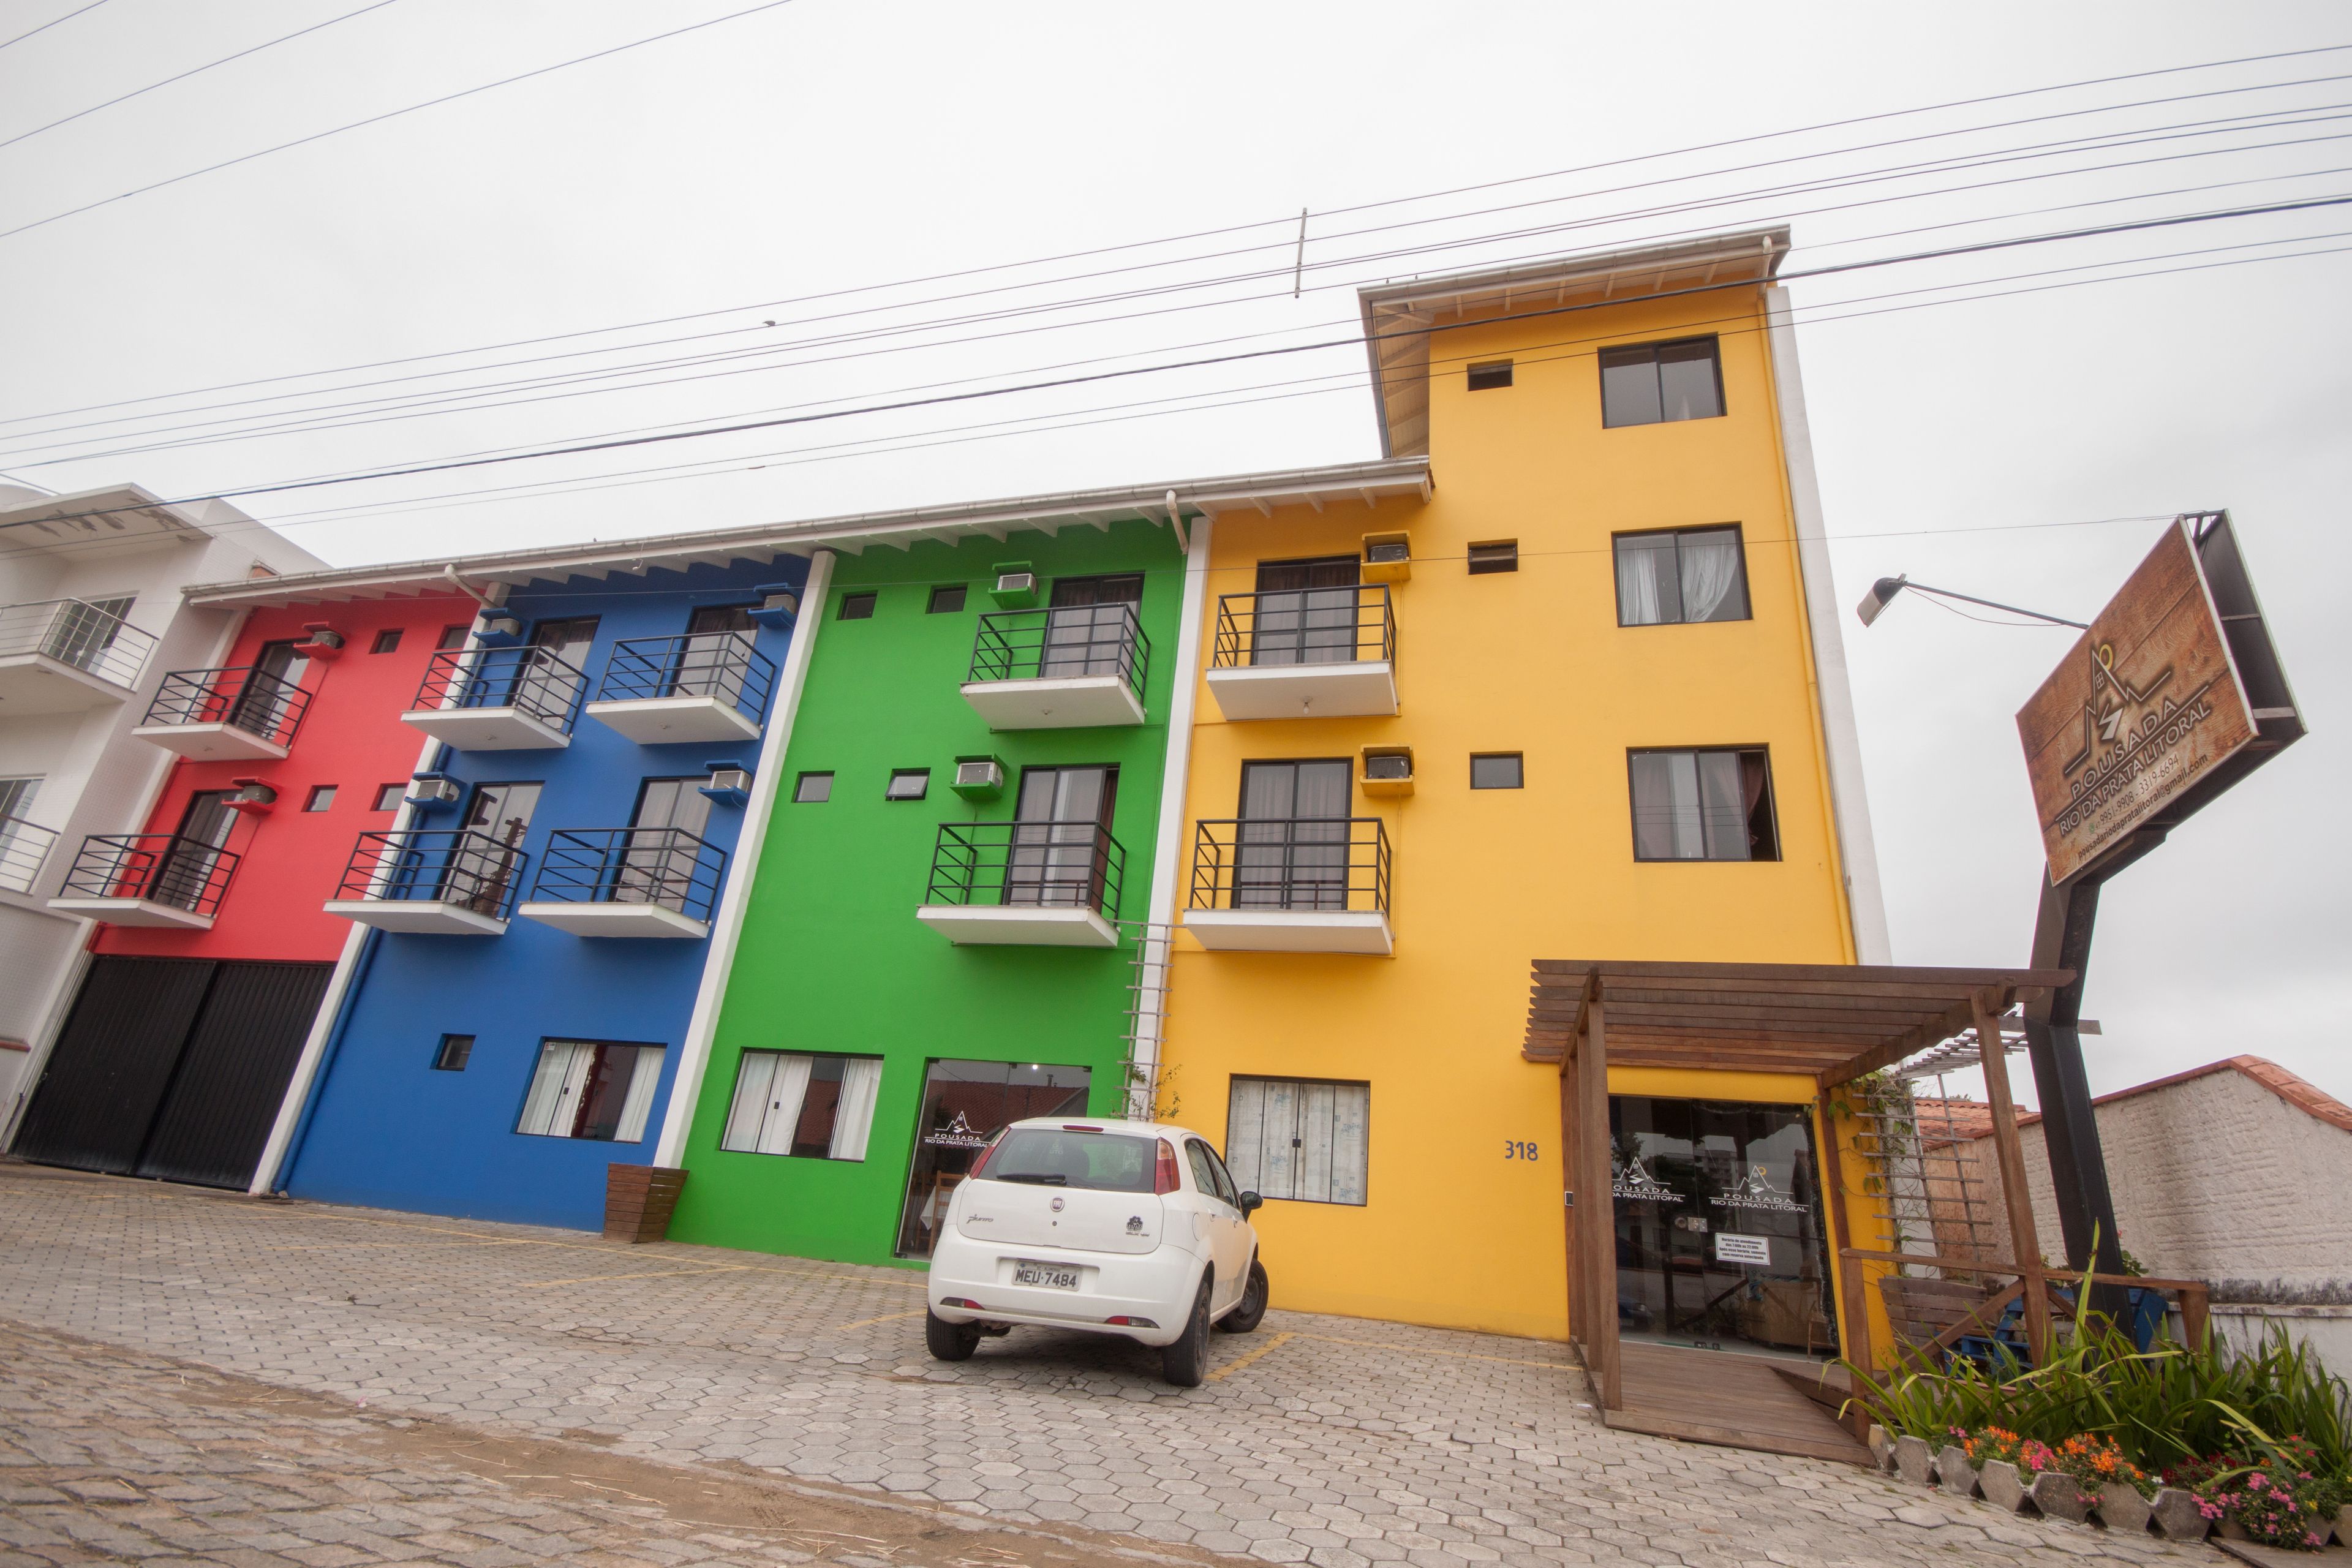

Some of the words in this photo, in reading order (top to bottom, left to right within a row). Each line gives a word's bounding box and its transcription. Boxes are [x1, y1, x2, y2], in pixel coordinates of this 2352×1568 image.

[2071, 699, 2177, 799] POUSADA
[2059, 812, 2081, 835] RIO
[2082, 794, 2102, 816] DA
[2102, 760, 2143, 801] PRATA
[2144, 702, 2211, 764] LITORAL
[2139, 754, 2179, 795] 3319-6694
[1505, 1140, 1539, 1161] 318
[1613, 1185, 1670, 1194] OUSADA
[1724, 1193, 1793, 1204] POUSADA
